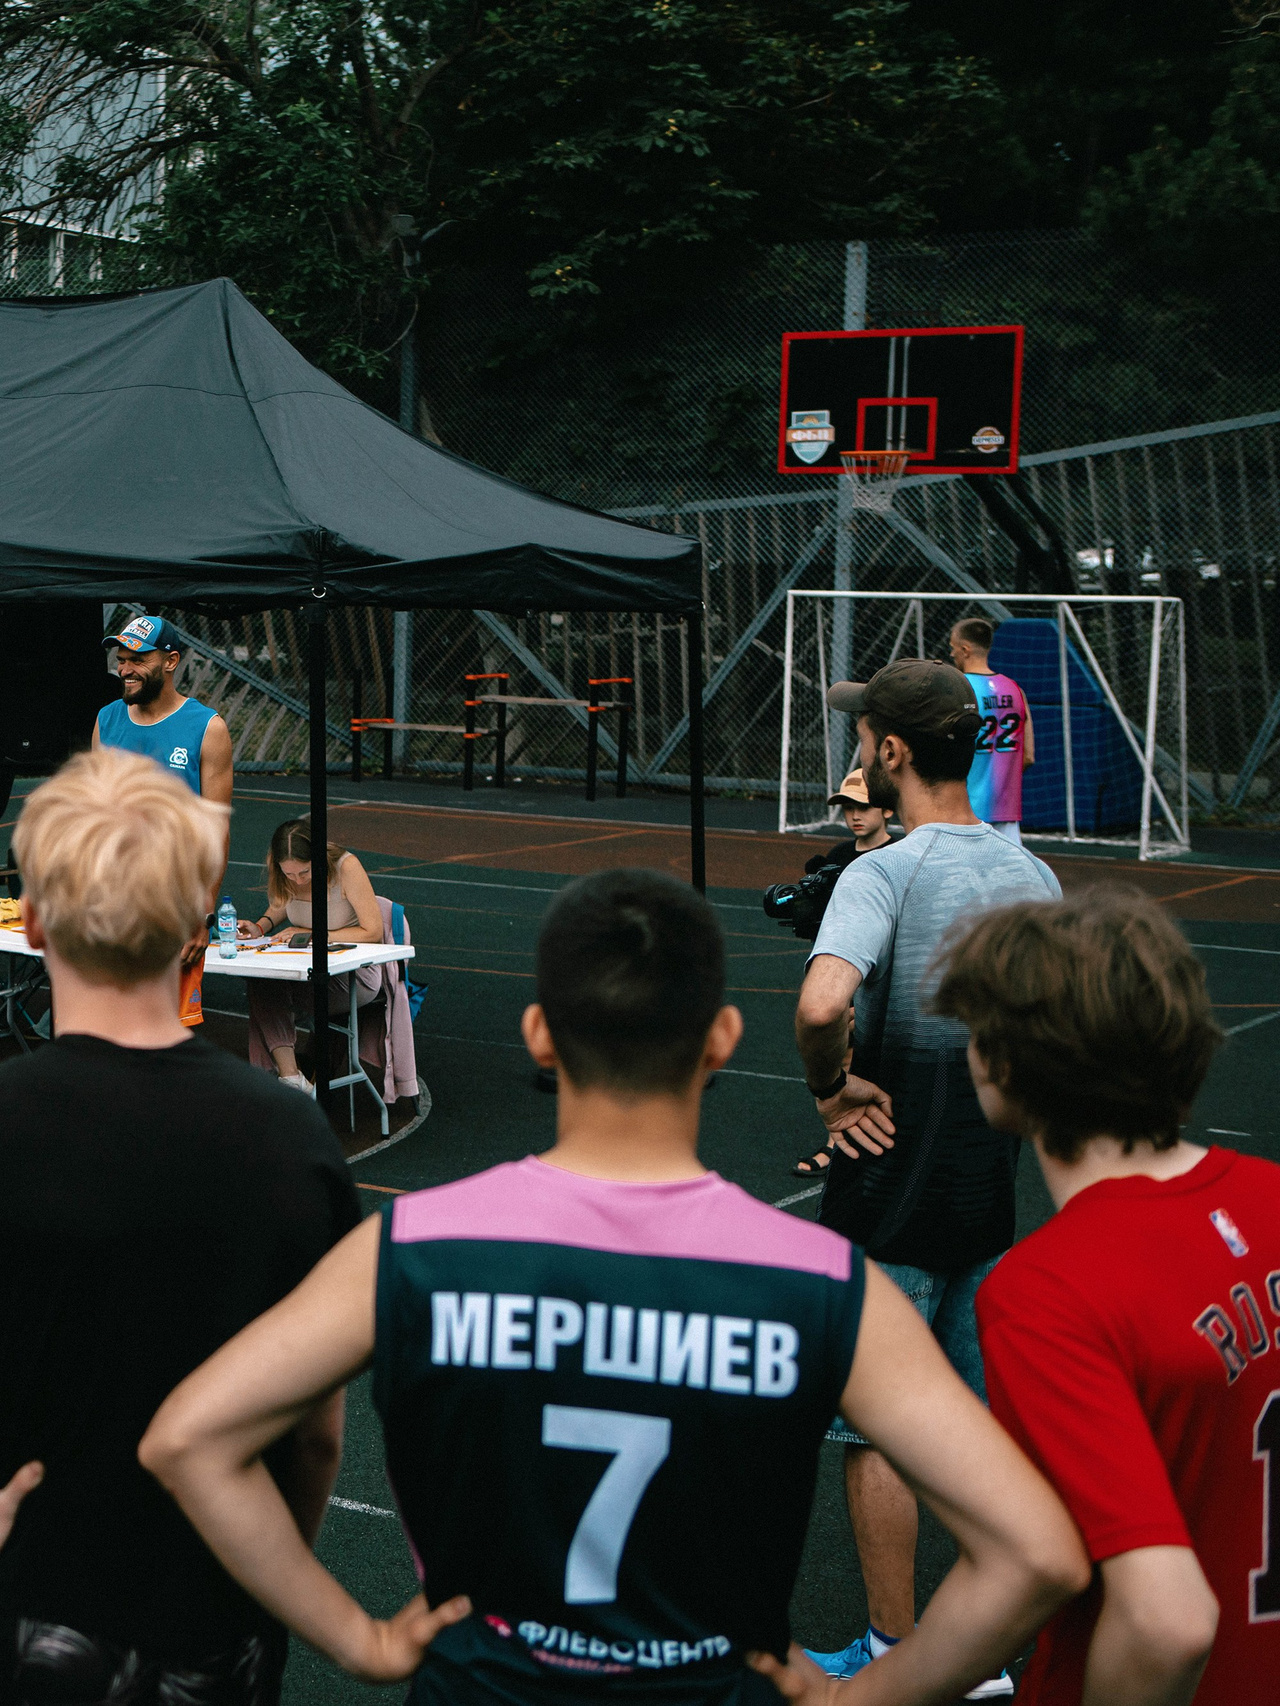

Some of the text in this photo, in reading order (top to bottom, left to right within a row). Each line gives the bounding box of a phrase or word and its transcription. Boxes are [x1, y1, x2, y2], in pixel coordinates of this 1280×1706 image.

[975, 712, 1021, 753] 22
[982, 694, 1014, 710] BUTLER
[431, 1291, 800, 1398] МЕРШИЕВ
[541, 1403, 672, 1605] 7
